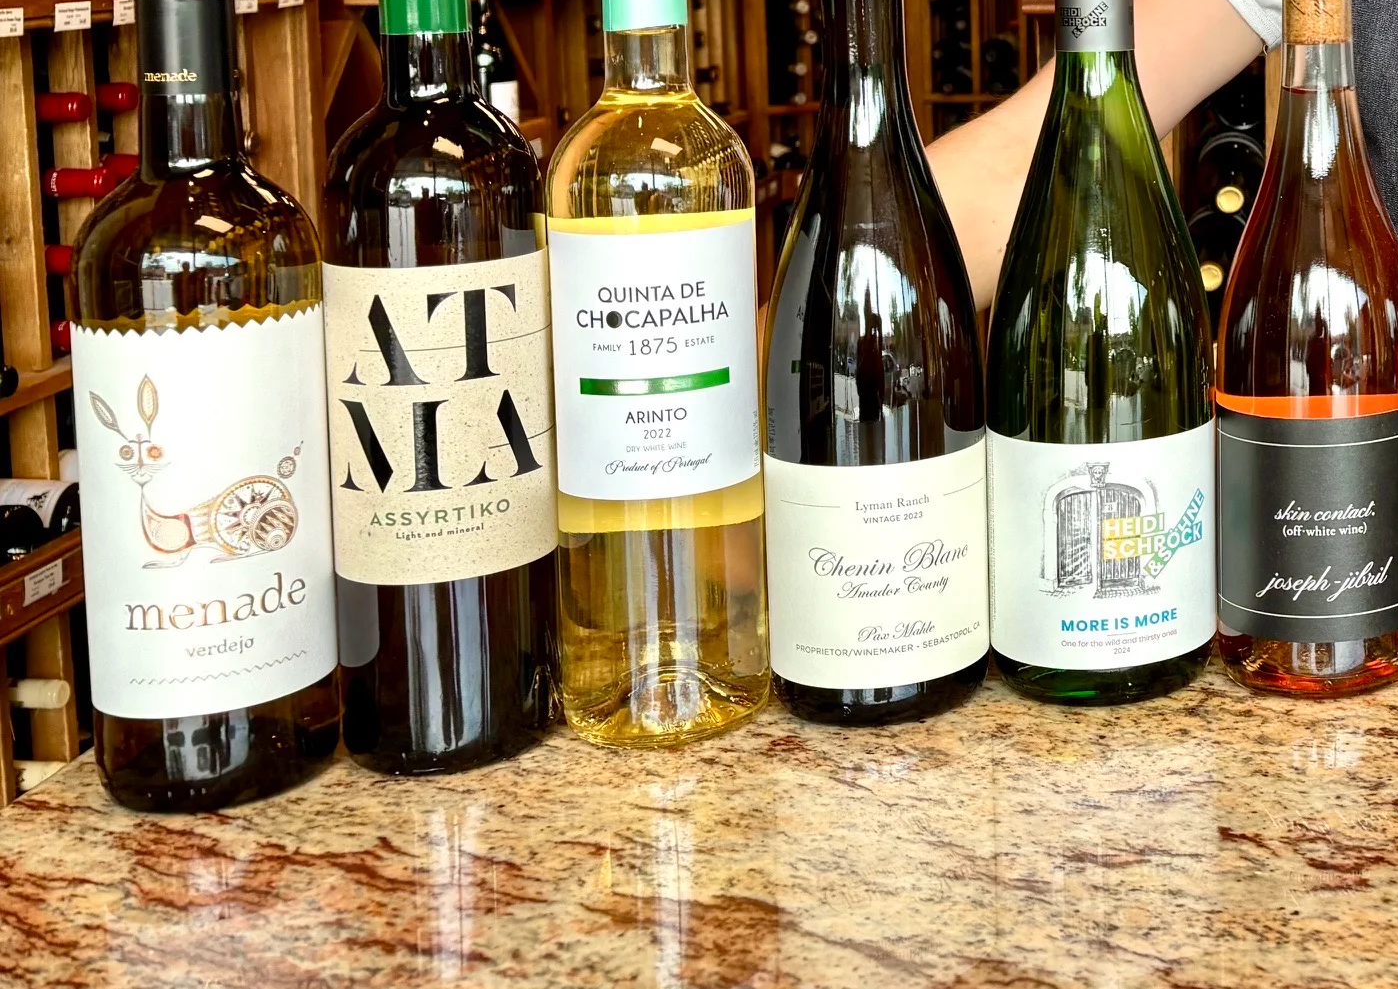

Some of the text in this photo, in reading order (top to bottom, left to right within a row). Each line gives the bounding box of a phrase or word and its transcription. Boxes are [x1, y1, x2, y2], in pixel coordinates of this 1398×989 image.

[1063, 16, 1106, 26] CHRÖCK
[144, 69, 197, 82] menade
[598, 281, 706, 303] QUINTA DE
[576, 300, 729, 329] CHOCAPALHA
[342, 283, 517, 386] AT
[592, 335, 715, 355] FAMILY 1875 ESTATE
[625, 407, 687, 424] ARINTO
[338, 389, 544, 494] MA
[643, 428, 672, 440] 2022
[625, 441, 687, 453] DRY WHITE WINE
[605, 453, 713, 475] Product of Portugal
[370, 498, 511, 526] ASSYRTIKO
[855, 494, 930, 513] Lyman Ranch
[1274, 500, 1376, 522] skin contact.
[863, 511, 923, 524] VINTAGE 2023
[1104, 513, 1165, 539] HEIDI
[1158, 491, 1204, 562] SÖHNE
[396, 523, 485, 542] Light and mineral
[1282, 522, 1367, 538] (off-white wine)
[1104, 523, 1201, 560] SCHRÖCK
[808, 539, 968, 576] Chenin Blanc
[837, 575, 949, 599] Amador County
[125, 572, 307, 631] menade
[1061, 608, 1178, 632] MORE IS MORE
[186, 636, 255, 658] verdejo
[796, 643, 914, 657] PROPRIETOR/WINEMAKER
[922, 627, 972, 649] SEBASTOPOL
[1061, 640, 1077, 648] One
[1078, 639, 1089, 647] for
[1104, 638, 1121, 646] wild
[1122, 636, 1137, 644] and
[1138, 633, 1160, 644] thirsty
[1162, 629, 1178, 638] ones
[1113, 647, 1131, 655] 2024
